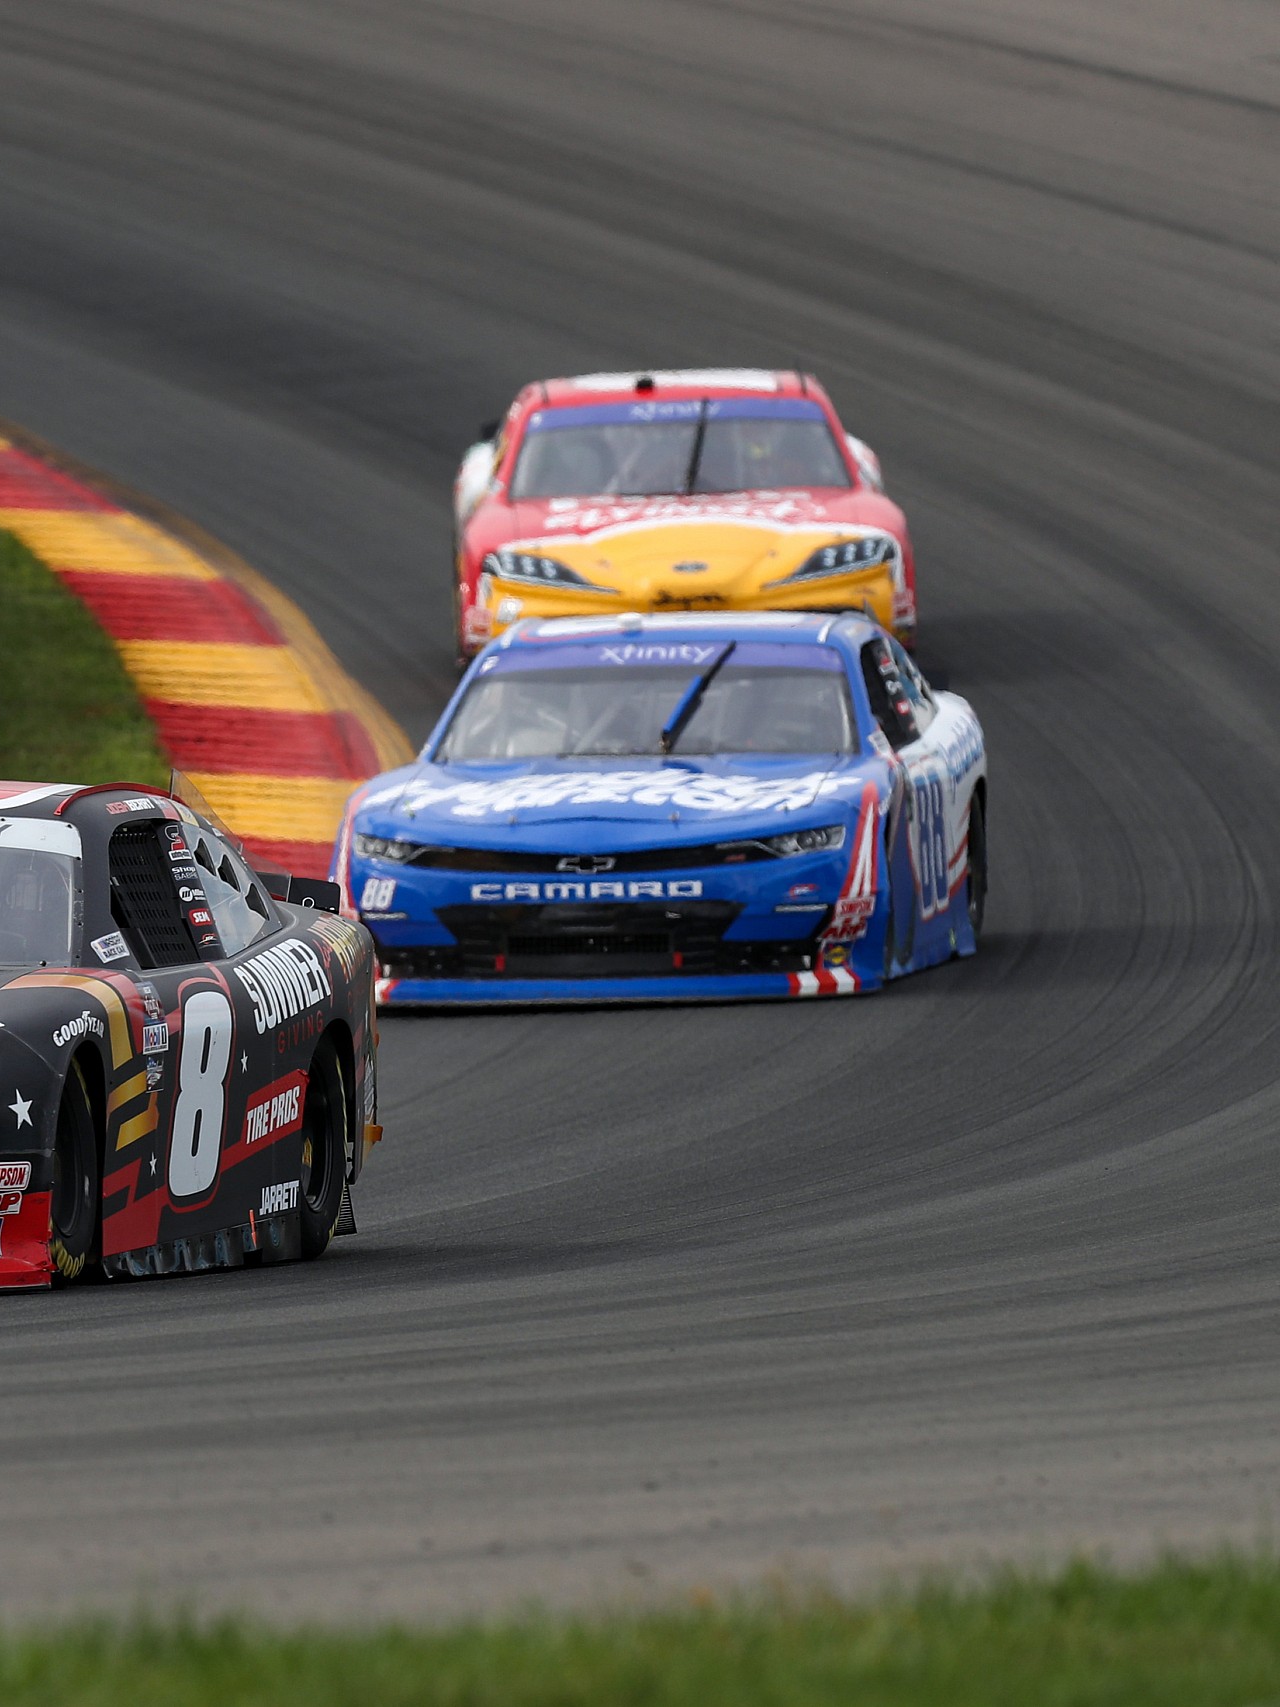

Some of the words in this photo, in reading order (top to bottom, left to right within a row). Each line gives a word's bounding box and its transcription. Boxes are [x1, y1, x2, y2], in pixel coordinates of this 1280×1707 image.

[600, 644, 714, 664] xfinity
[360, 877, 397, 911] 88
[471, 880, 703, 900] CAMARO
[233, 938, 332, 1035] SUMMER
[53, 1010, 104, 1047] GOODYEAR
[277, 1009, 324, 1054] GIVING
[169, 990, 232, 1198] 8
[246, 1101, 271, 1145] TIRE
[269, 1085, 301, 1132] PROS
[259, 1180, 300, 1216] JARRETT
